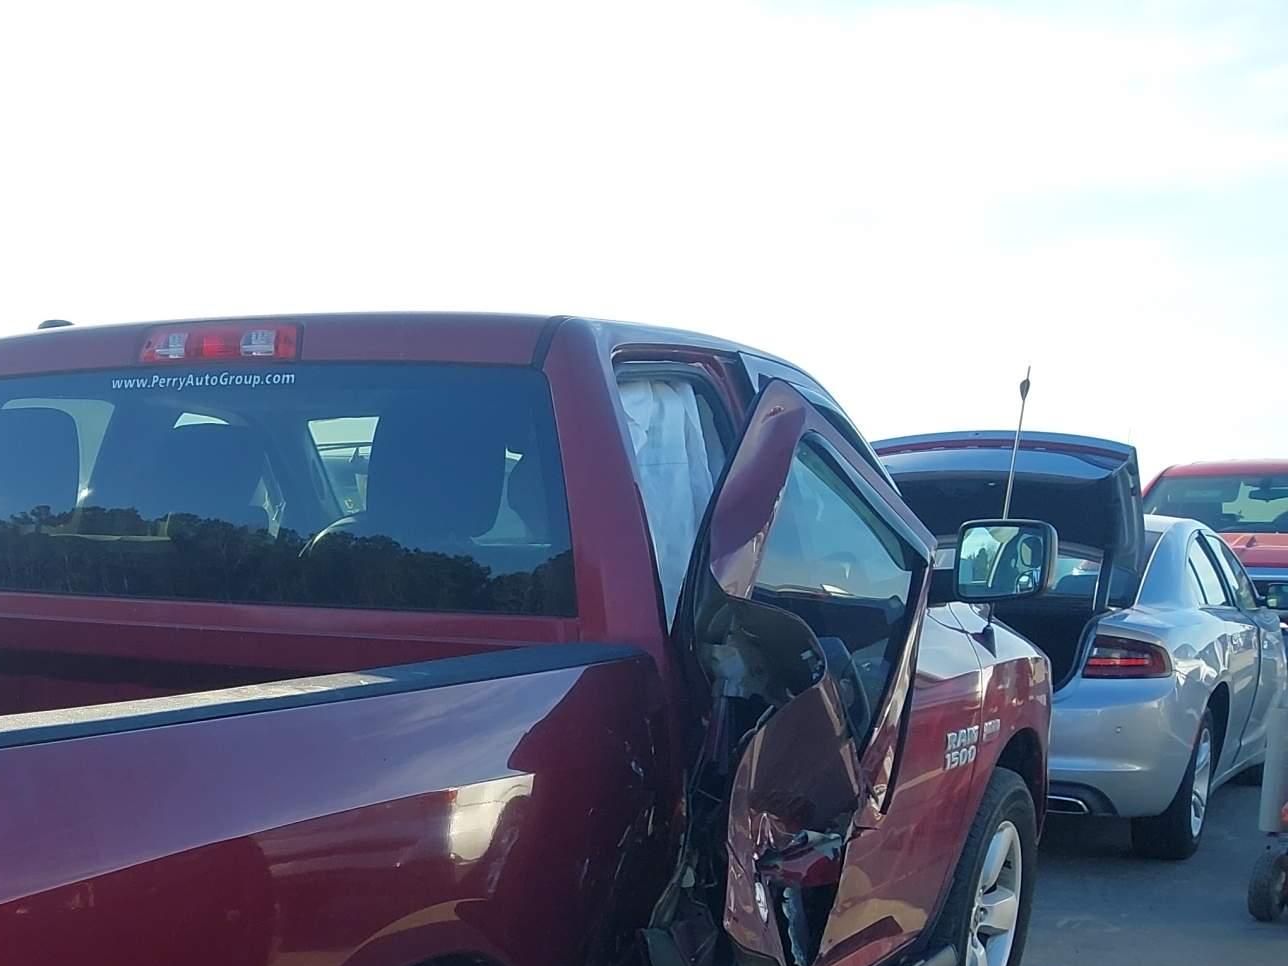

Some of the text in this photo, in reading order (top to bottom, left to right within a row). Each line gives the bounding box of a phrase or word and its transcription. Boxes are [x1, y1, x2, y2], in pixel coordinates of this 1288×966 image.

[111, 371, 296, 391] www.PerryAutoGroup.com
[946, 725, 979, 751] RAM
[944, 745, 977, 770] 1500
